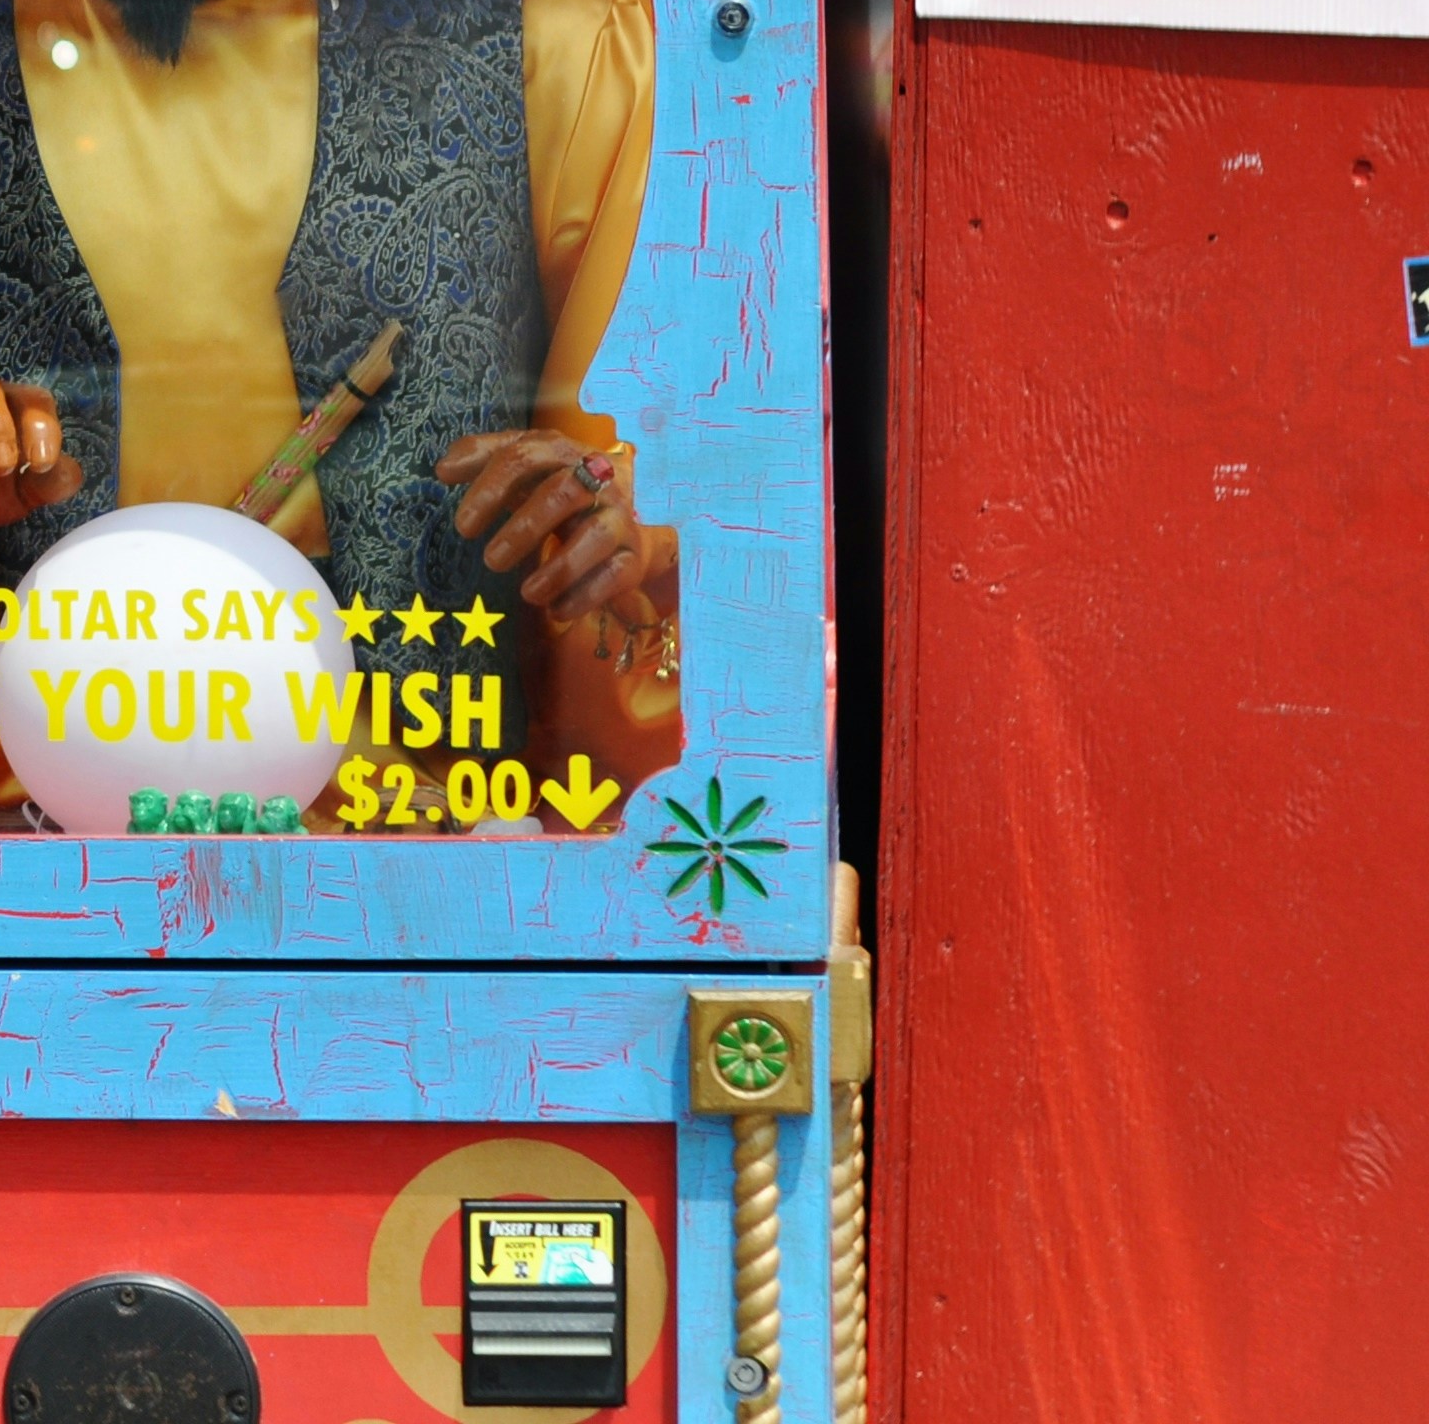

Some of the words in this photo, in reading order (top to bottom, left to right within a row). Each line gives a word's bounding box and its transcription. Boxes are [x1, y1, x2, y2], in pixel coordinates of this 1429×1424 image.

[183, 588, 320, 643] SAYS
[30, 668, 254, 743] YOUR
[284, 671, 503, 749] WISH
[336, 754, 532, 829] $2.00
[490, 1220, 533, 1237] INSERT
[534, 1222, 560, 1237] BILL
[562, 1223, 594, 1237] HERE
